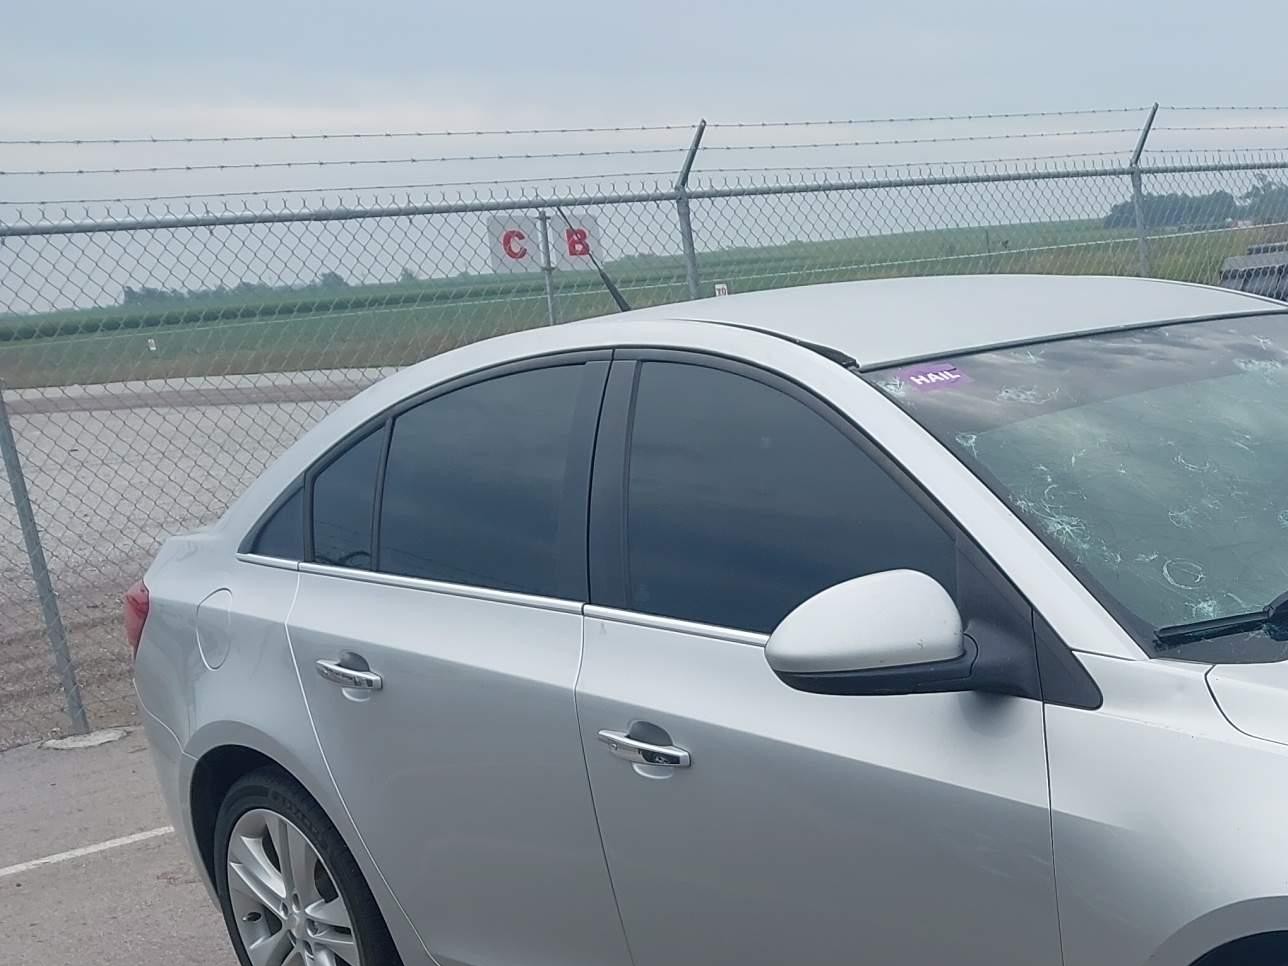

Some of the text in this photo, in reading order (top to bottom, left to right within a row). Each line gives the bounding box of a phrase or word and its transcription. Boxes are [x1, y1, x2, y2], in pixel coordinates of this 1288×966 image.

[501, 229, 528, 260] C
[565, 227, 591, 257] B
[909, 369, 961, 386] HAIL
